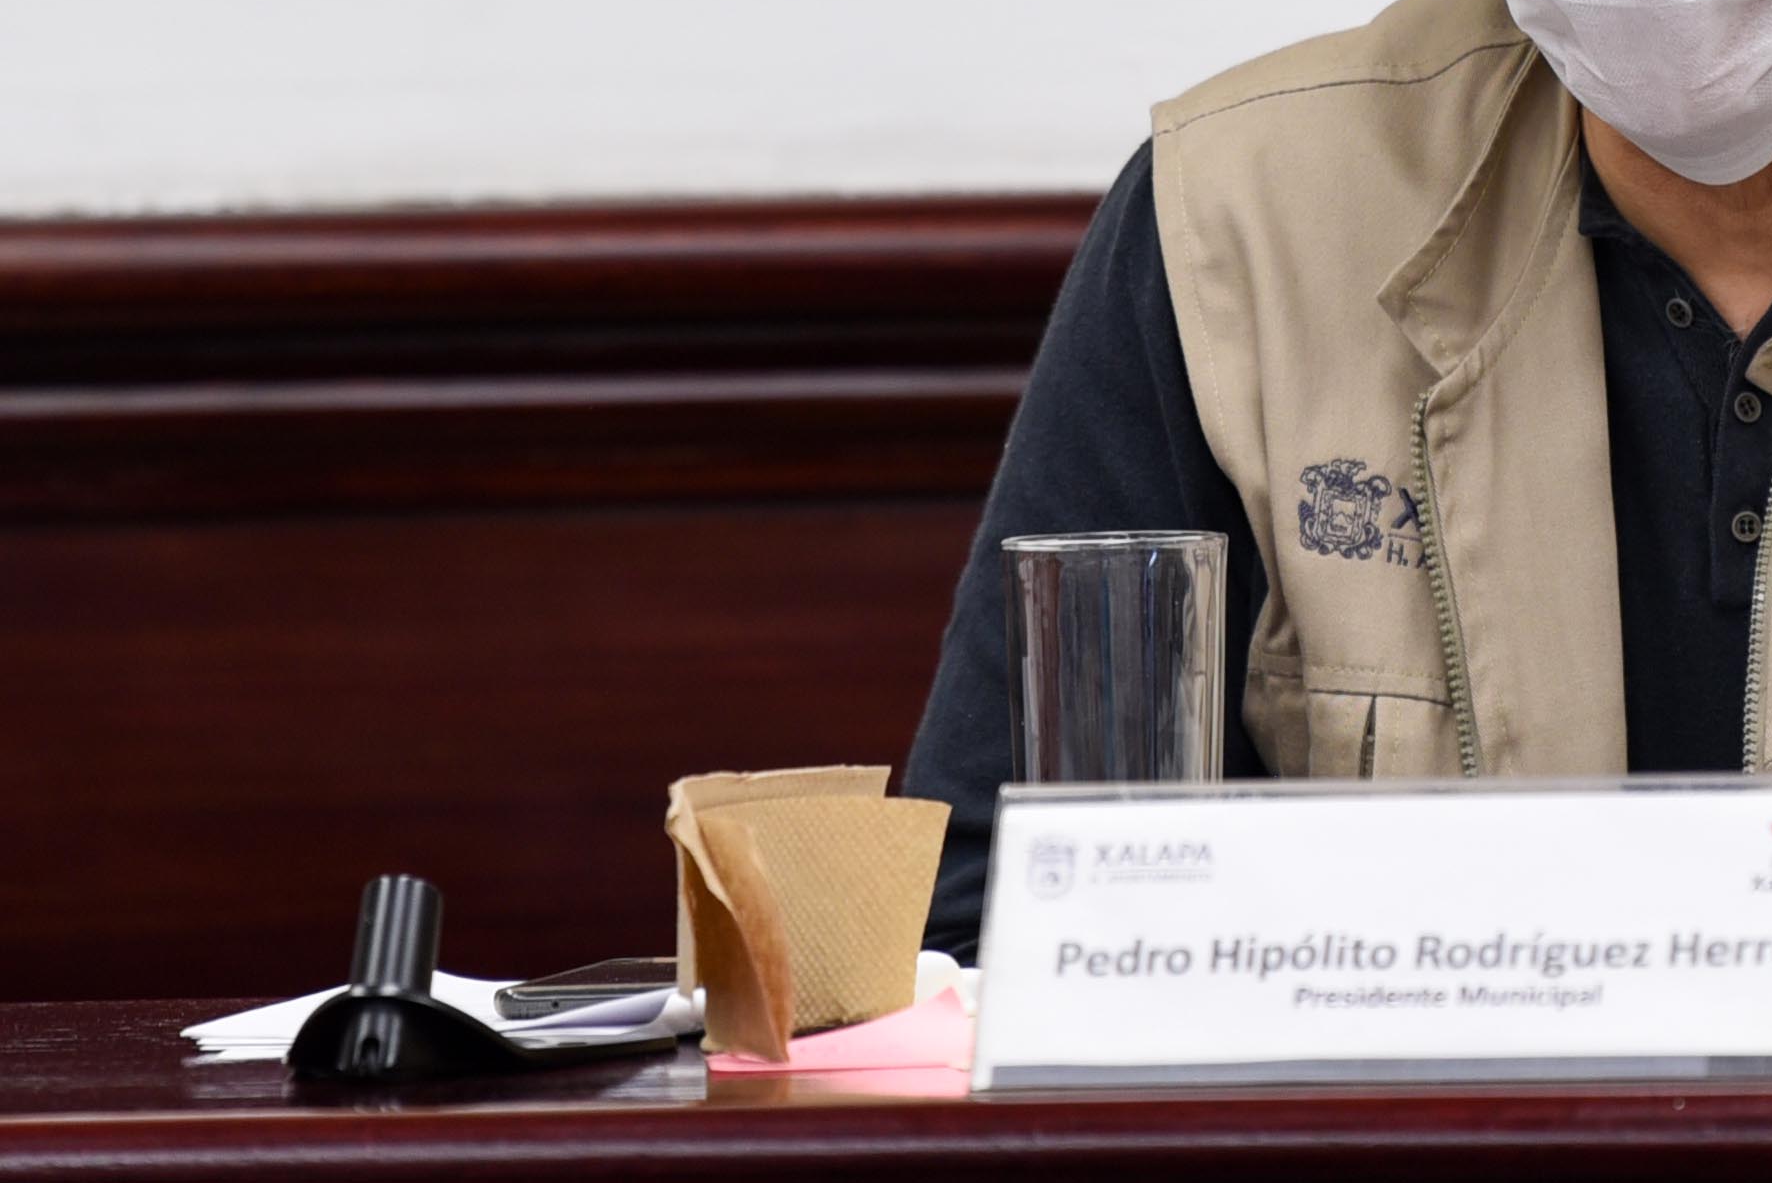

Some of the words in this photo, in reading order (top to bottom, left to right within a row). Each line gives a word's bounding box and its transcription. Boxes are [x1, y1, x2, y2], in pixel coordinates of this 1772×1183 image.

[1095, 843, 1213, 866] XALAPA
[1056, 937, 1194, 977] Pedro
[1210, 931, 1399, 981] Hipólito
[1414, 931, 1651, 978] Rodríguez
[1293, 986, 1448, 1008] Presidente
[1457, 984, 1604, 1010] Municipal
